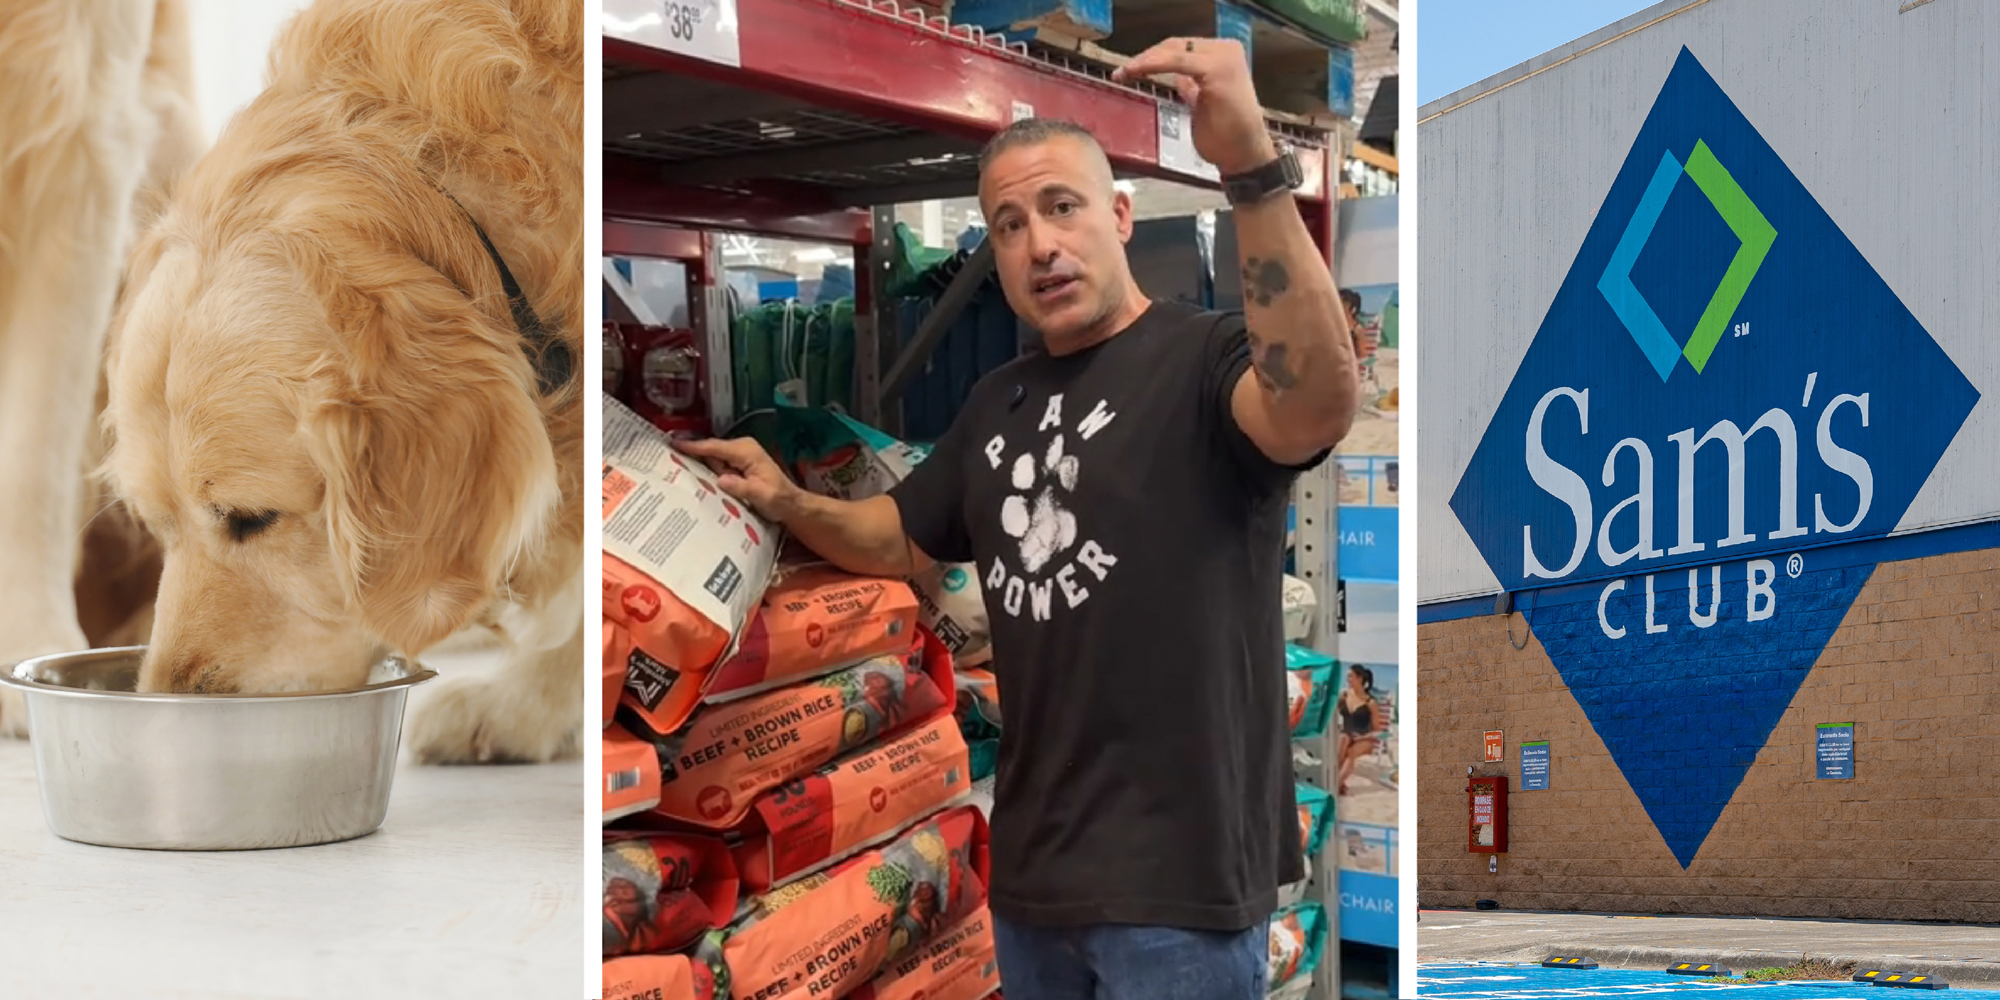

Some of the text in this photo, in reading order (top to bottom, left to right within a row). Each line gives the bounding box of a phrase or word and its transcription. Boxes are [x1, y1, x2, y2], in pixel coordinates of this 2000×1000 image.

[1734, 321, 1750, 338] SM
[985, 393, 1117, 470] PAW
[1523, 372, 1874, 579] Sam's
[986, 539, 1118, 622] POWER
[826, 599, 863, 614] RECIPE
[680, 695, 835, 771] BEEF + BROWN RICE
[709, 693, 801, 738] LIMITED INGREDIENT
[745, 729, 801, 762] RECIPE
[852, 757, 877, 774] BEEF
[885, 740, 921, 760] BROWN
[920, 729, 940, 746] RICE
[889, 752, 921, 773] RECIPE
[1339, 892, 1395, 914] CHAIR
[771, 913, 863, 976] LIMITED INGREDIENT
[805, 935, 862, 975] BROWN
[862, 913, 889, 941] RICE
[932, 947, 962, 973] RECIPE
[807, 956, 858, 996] RECIPE
[896, 956, 921, 977] BEEF
